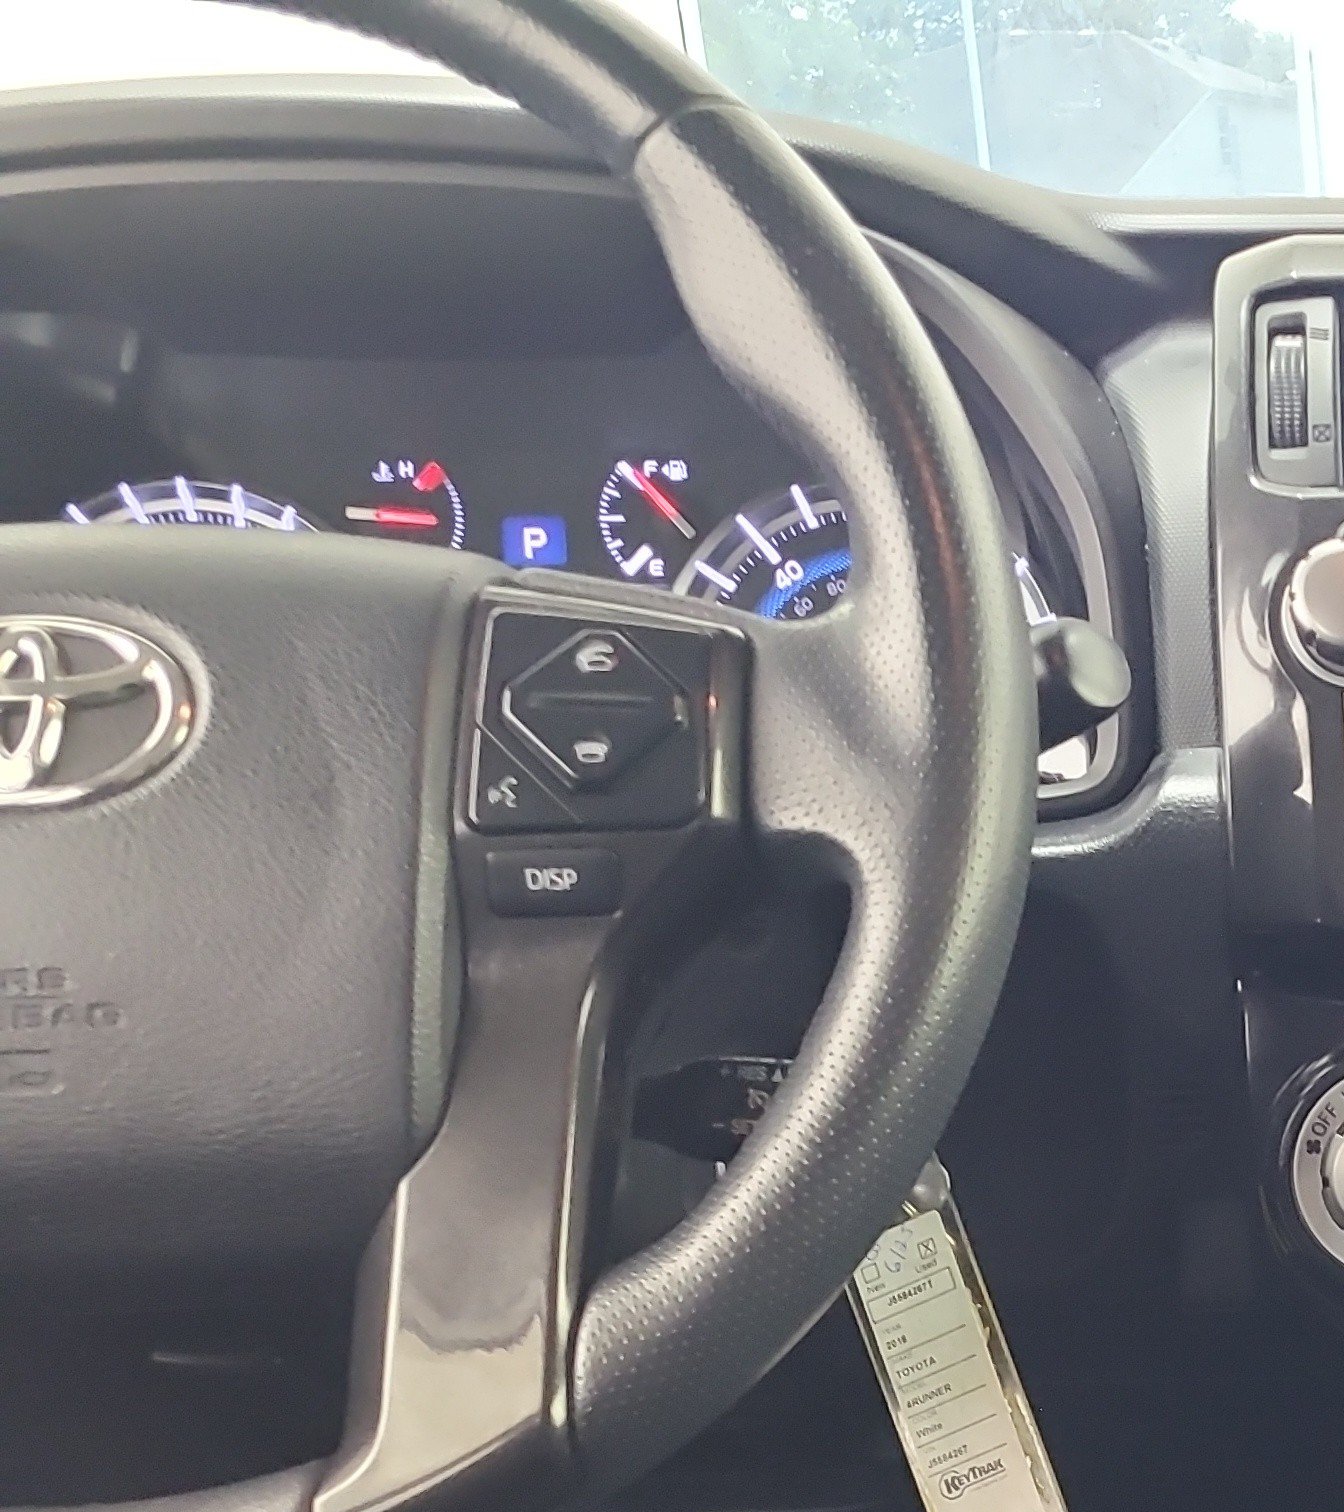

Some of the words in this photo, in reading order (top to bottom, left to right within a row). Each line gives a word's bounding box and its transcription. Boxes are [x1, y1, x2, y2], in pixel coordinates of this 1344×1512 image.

[398, 459, 414, 479] H
[643, 459, 659, 479] F
[522, 526, 549, 560] P
[649, 557, 665, 577] E
[775, 560, 805, 590] 40
[524, 867, 578, 891] DISP
[1311, 1102, 1338, 1137] OFF
[895, 1356, 937, 1379] TOYOTA
[906, 1383, 952, 1408] 4RUNNER
[915, 1422, 943, 1438] White
